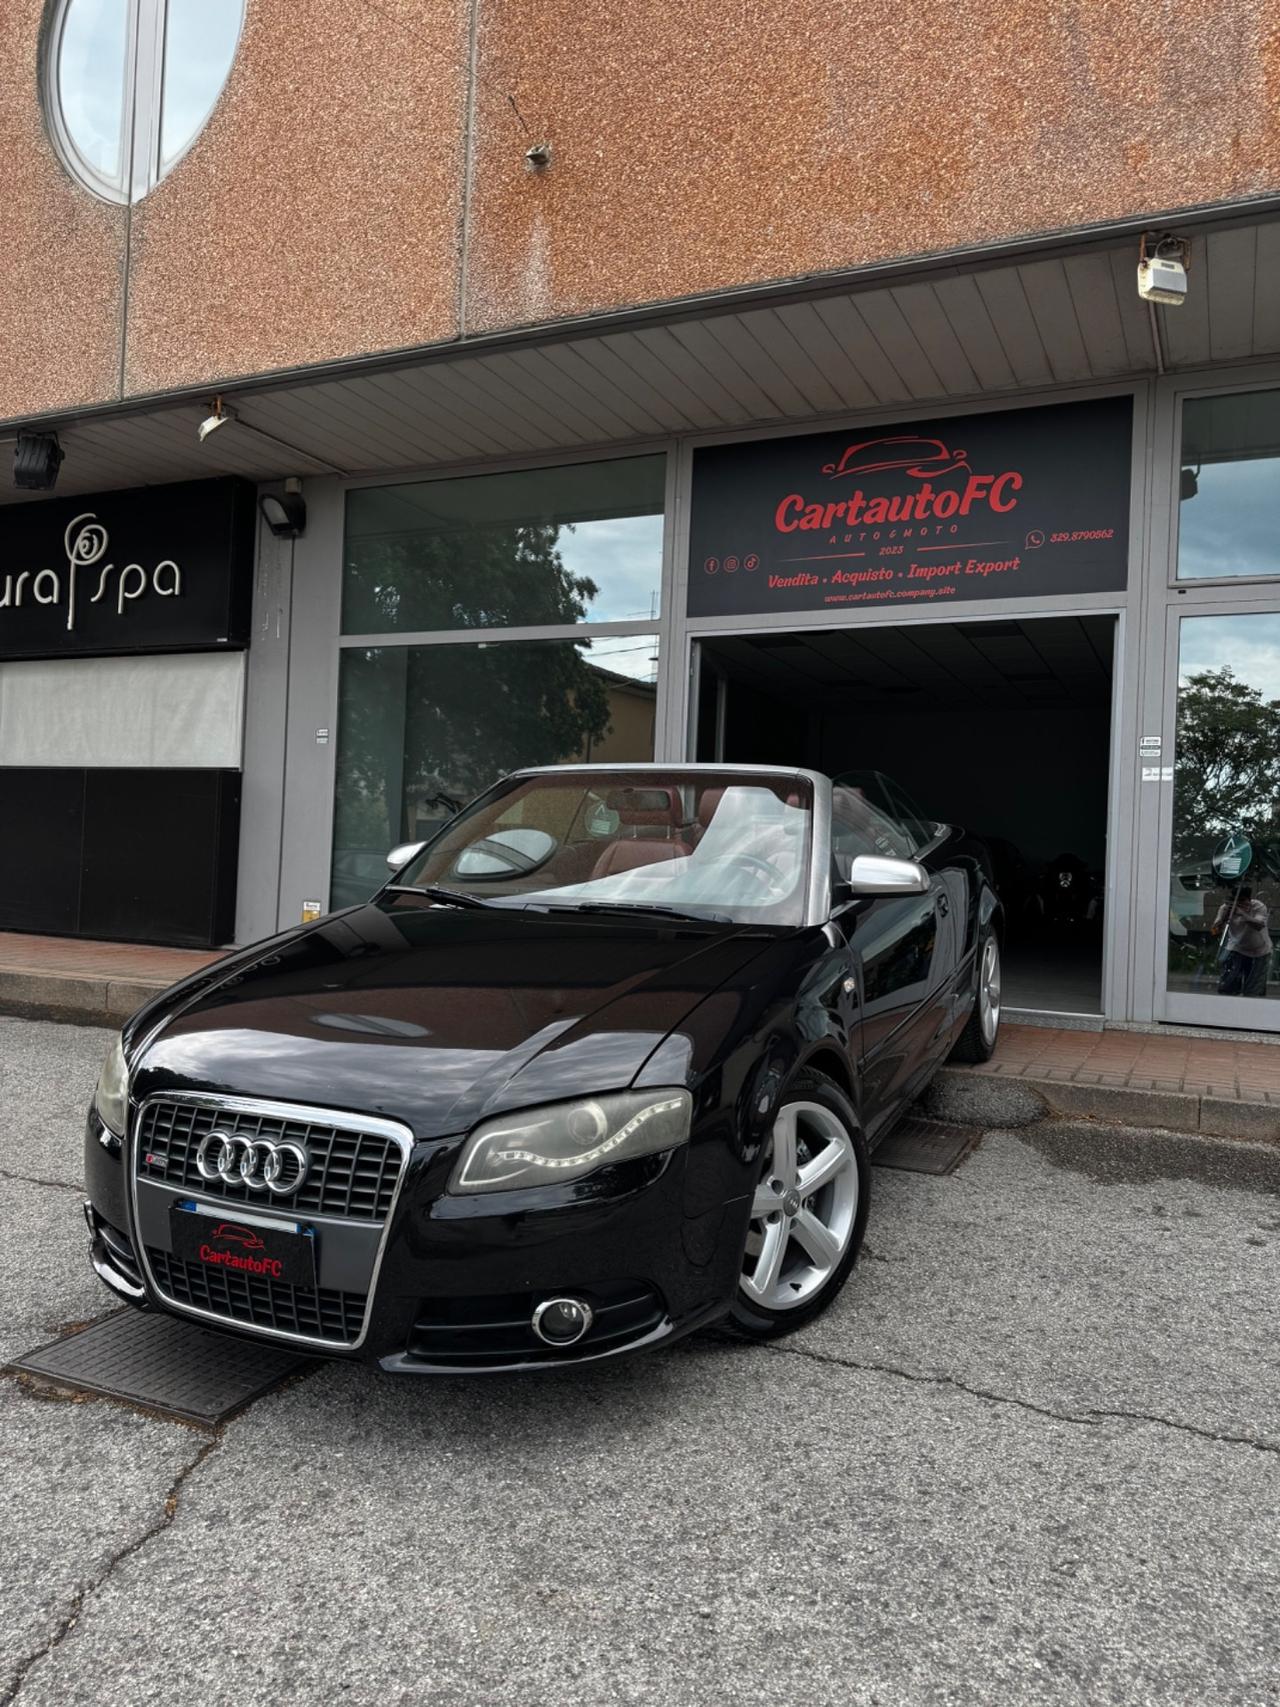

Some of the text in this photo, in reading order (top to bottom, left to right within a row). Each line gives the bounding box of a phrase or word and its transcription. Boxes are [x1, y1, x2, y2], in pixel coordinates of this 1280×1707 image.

[774, 471, 1023, 533] CartautoFC
[879, 545, 904, 556] 2023
[91, 560, 180, 614] spa
[768, 557, 1021, 588] Vendita Acquisto Import Export
[199, 1245, 283, 1278] CartautoFC
